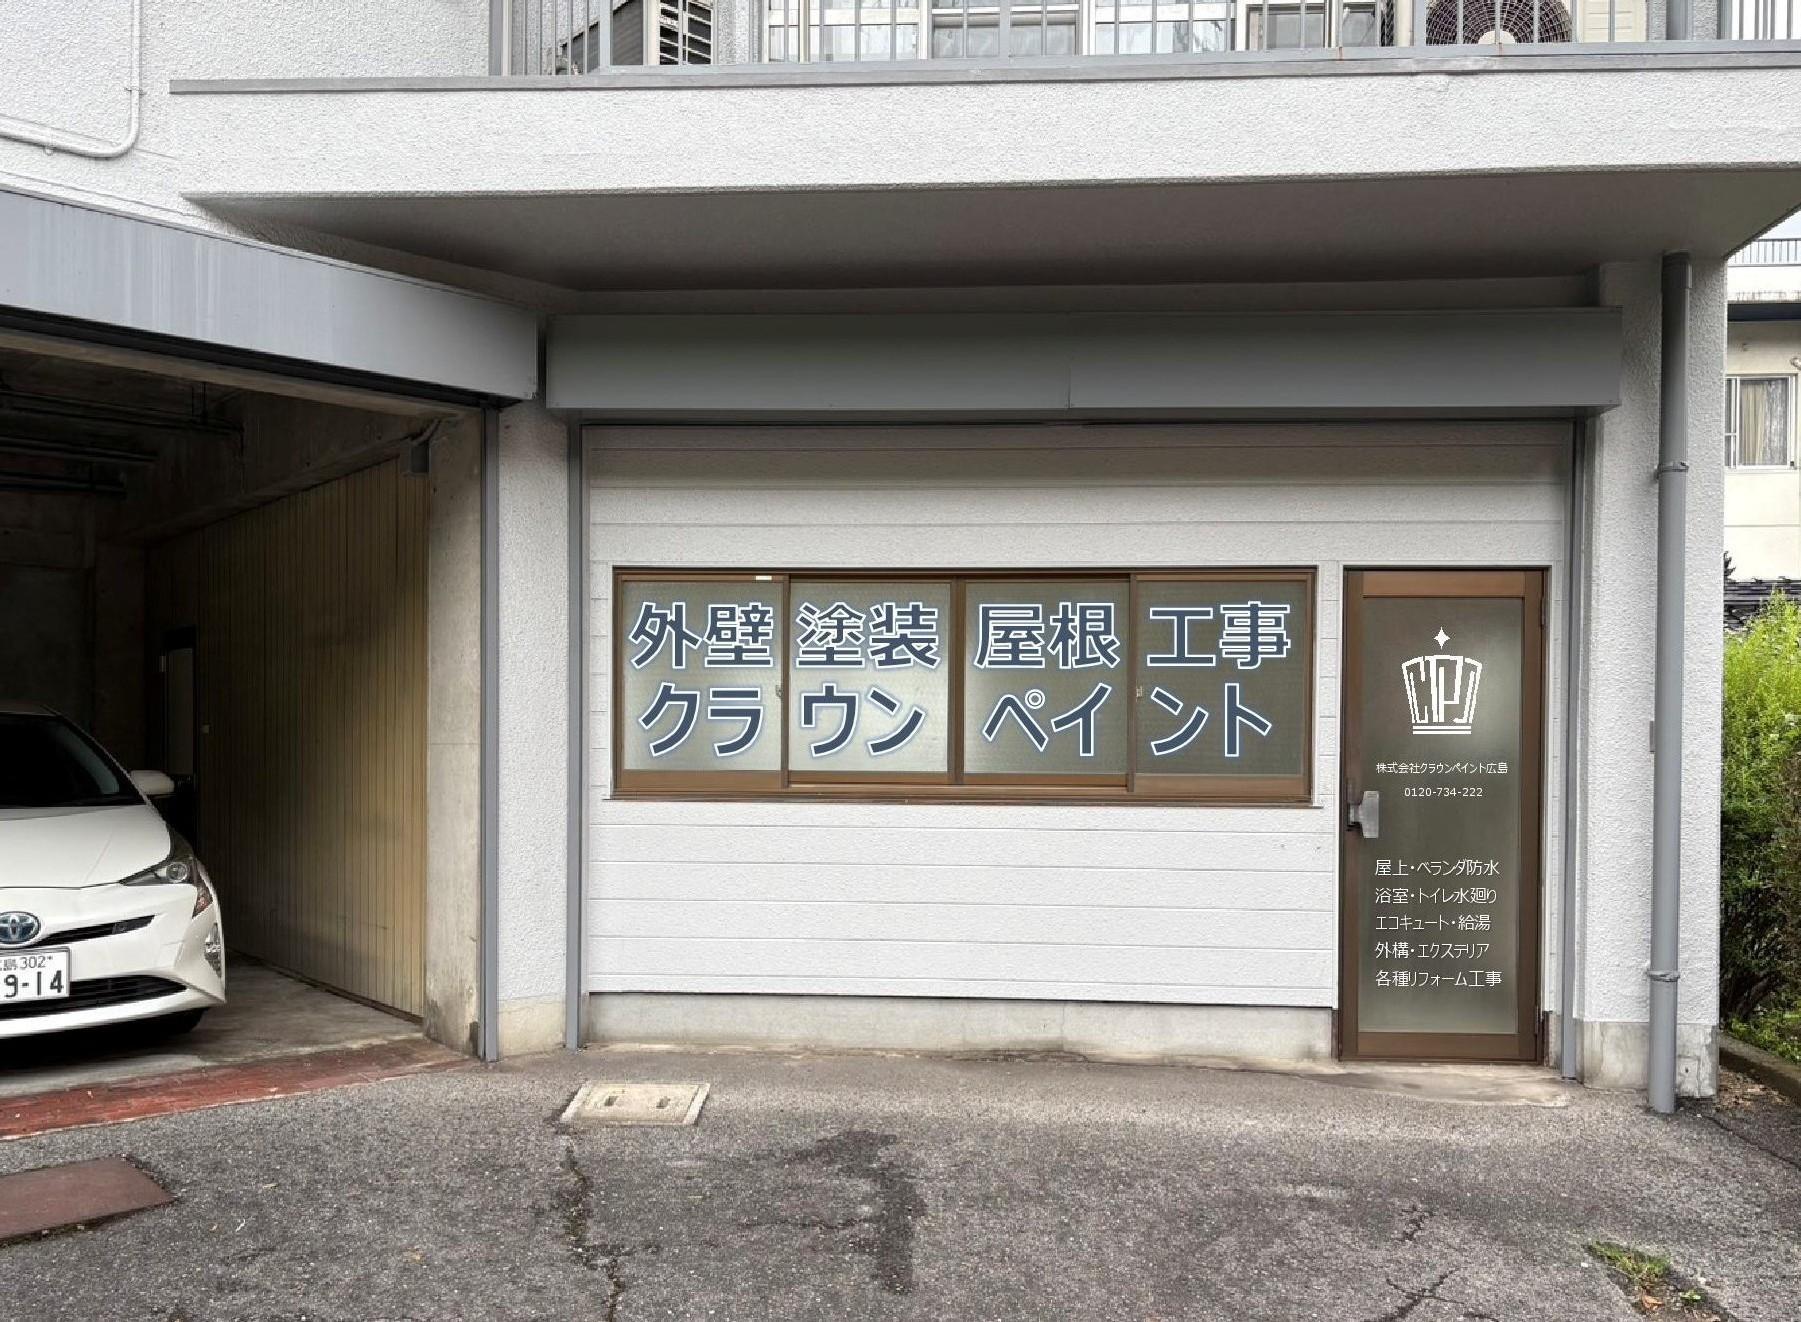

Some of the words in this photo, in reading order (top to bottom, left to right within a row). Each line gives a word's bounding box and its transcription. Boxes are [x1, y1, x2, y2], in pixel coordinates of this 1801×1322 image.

[638, 682, 1273, 757] クラウンペイント
[1376, 762, 1508, 774] 株式会社クラウンペイント広島
[1404, 787, 1483, 797] 0120-734-222
[1375, 859, 1500, 876] 屋上・ベランダ防水
[1375, 887, 1497, 904] 浴室・トイレ水廻り
[1375, 914, 1492, 931] エコキュート・給湯
[1375, 941, 1490, 959] 外構・エクステリア
[20, 955, 46, 969] 302
[1375, 970, 1502, 987] 各種リフォーム工事
